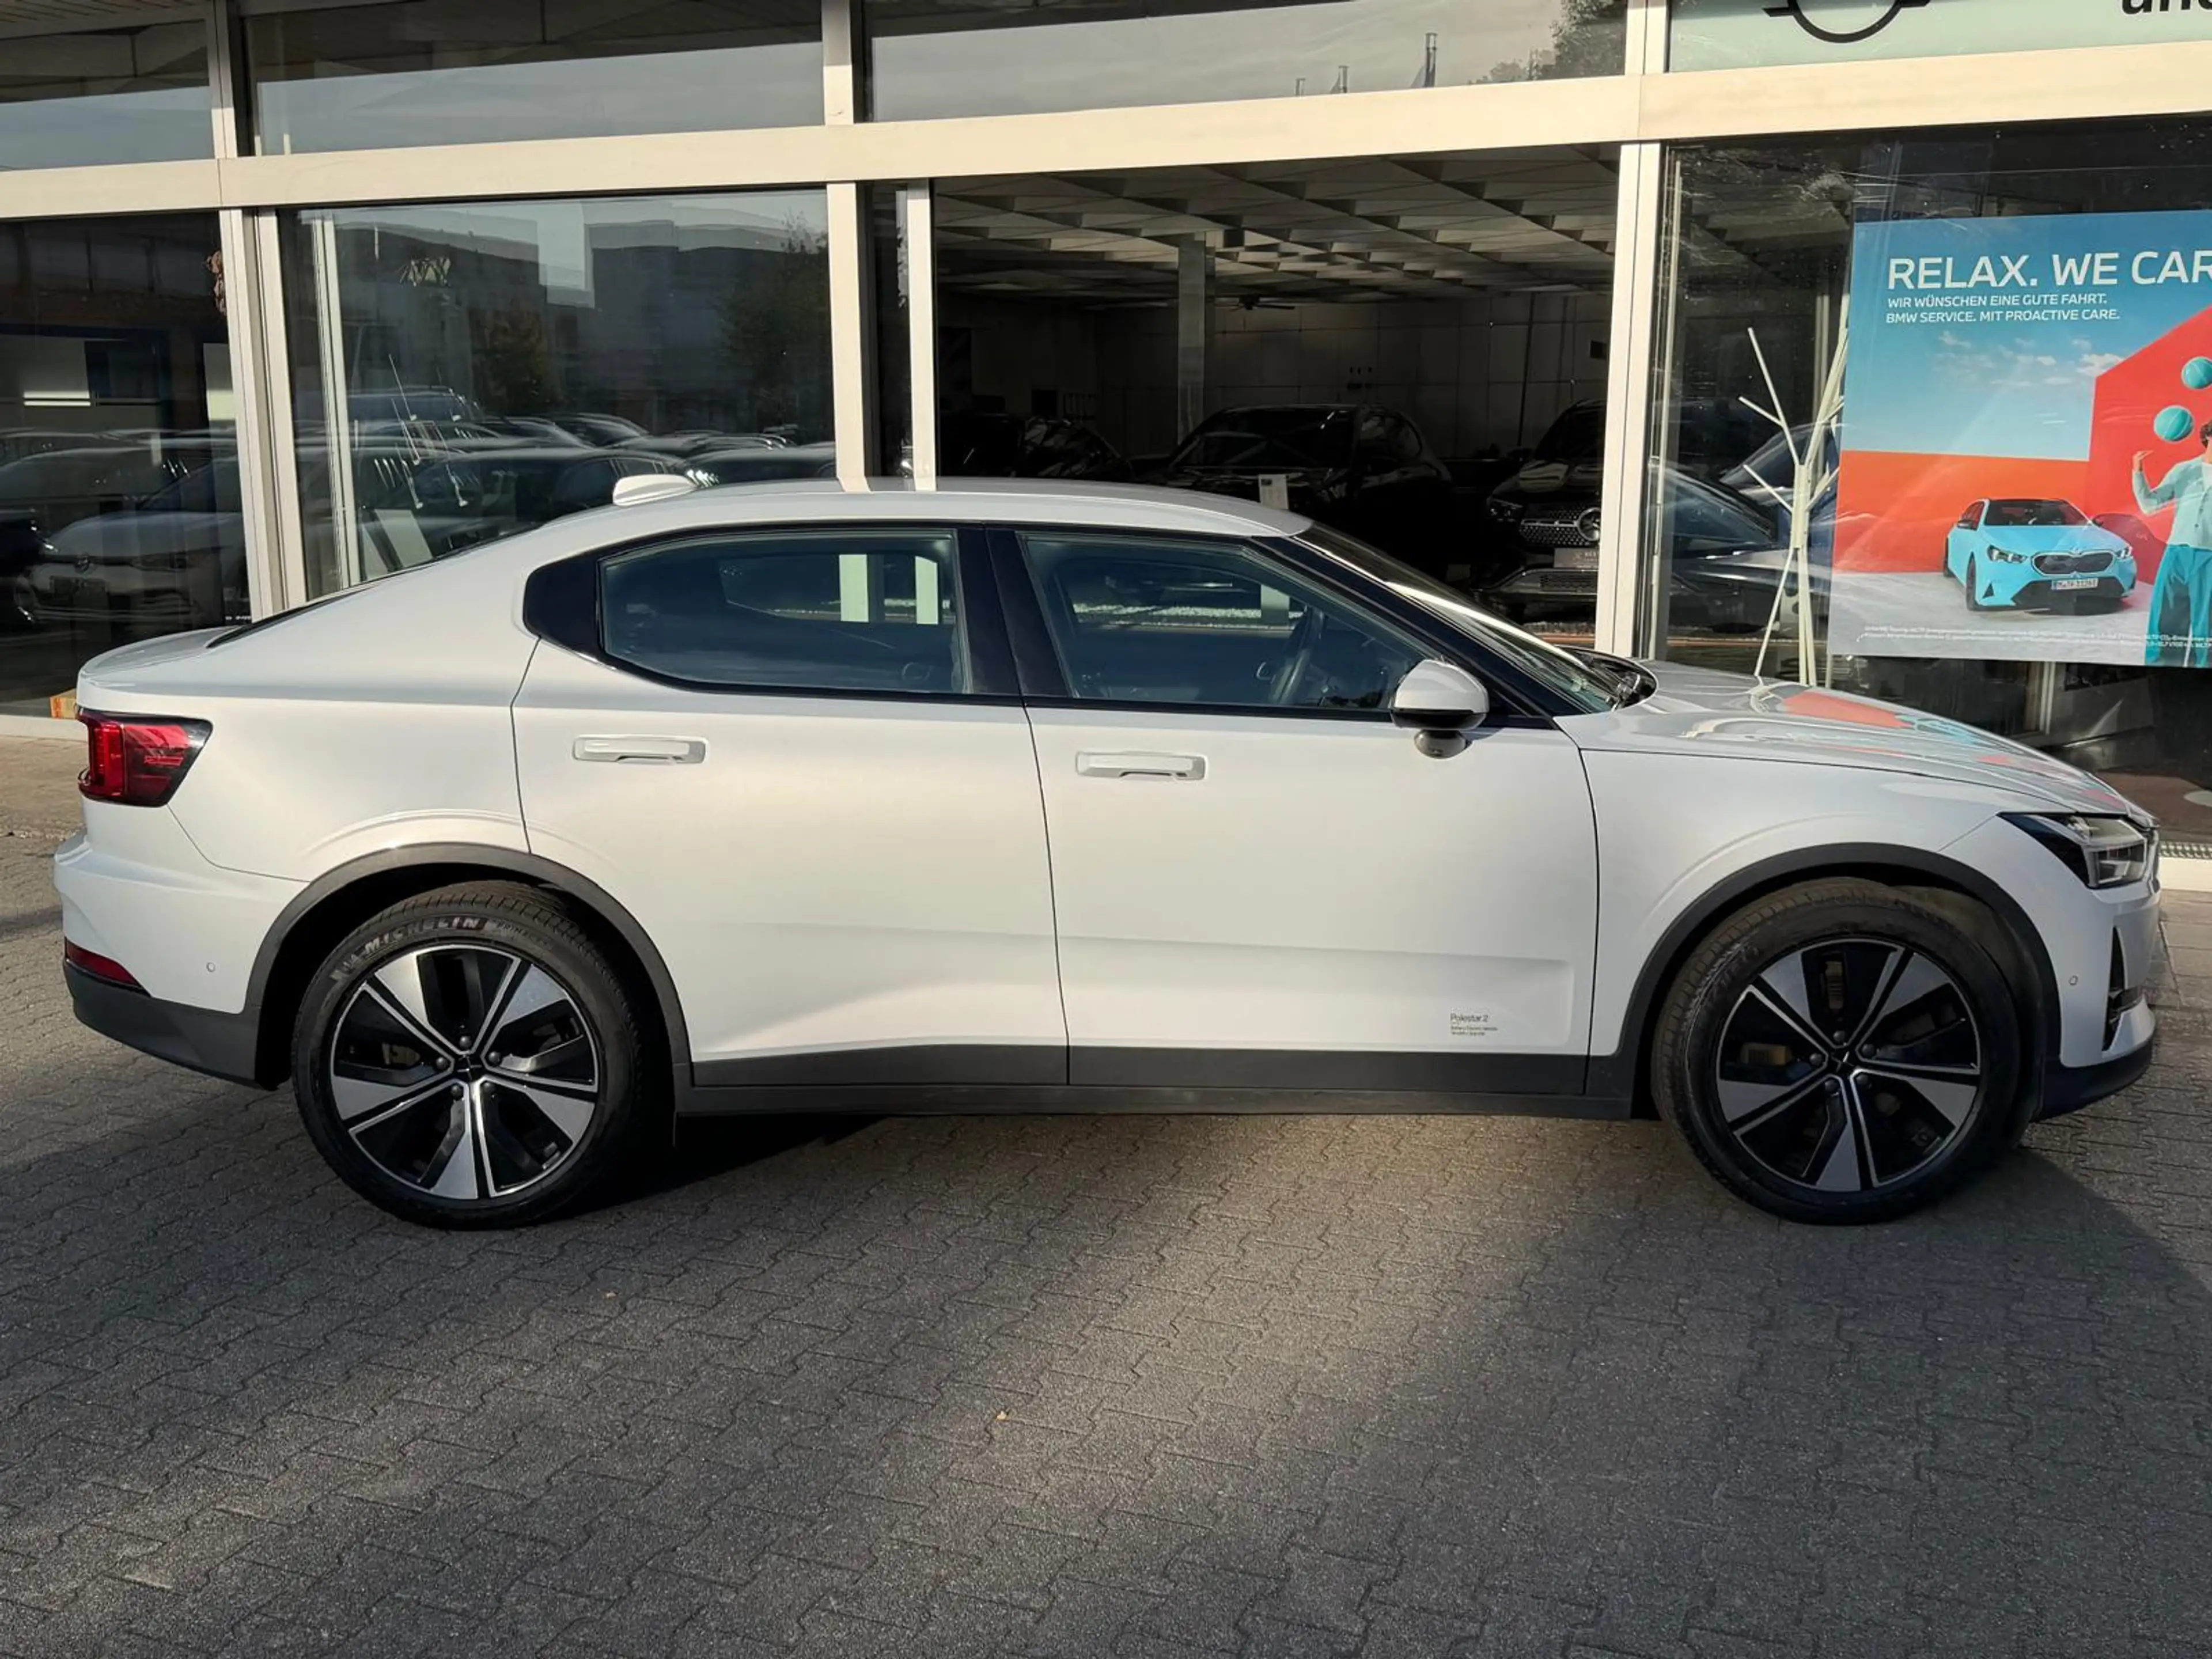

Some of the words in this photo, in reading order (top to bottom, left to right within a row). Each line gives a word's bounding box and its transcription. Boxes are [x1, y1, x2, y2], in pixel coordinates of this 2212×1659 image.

[1888, 255, 2038, 289] RELAX.
[2051, 252, 2120, 286] WE
[1888, 297, 1911, 308] WIR
[1914, 294, 1987, 308] WÜNSCHEN
[1990, 294, 2020, 306] EINE
[2022, 293, 2058, 306] GUTE
[2061, 292, 2108, 305] FAHRT.
[1885, 312, 1918, 324] BMW
[1919, 311, 1976, 322] SERVICE.
[1979, 310, 2003, 322] MIT
[2005, 309, 2079, 321] PROACTIVE
[2081, 308, 2120, 320] CARE.
[364, 916, 483, 954] MICHELIN
[1450, 1013, 1482, 1022] Polestar
[1482, 1013, 1488, 1022] 2
